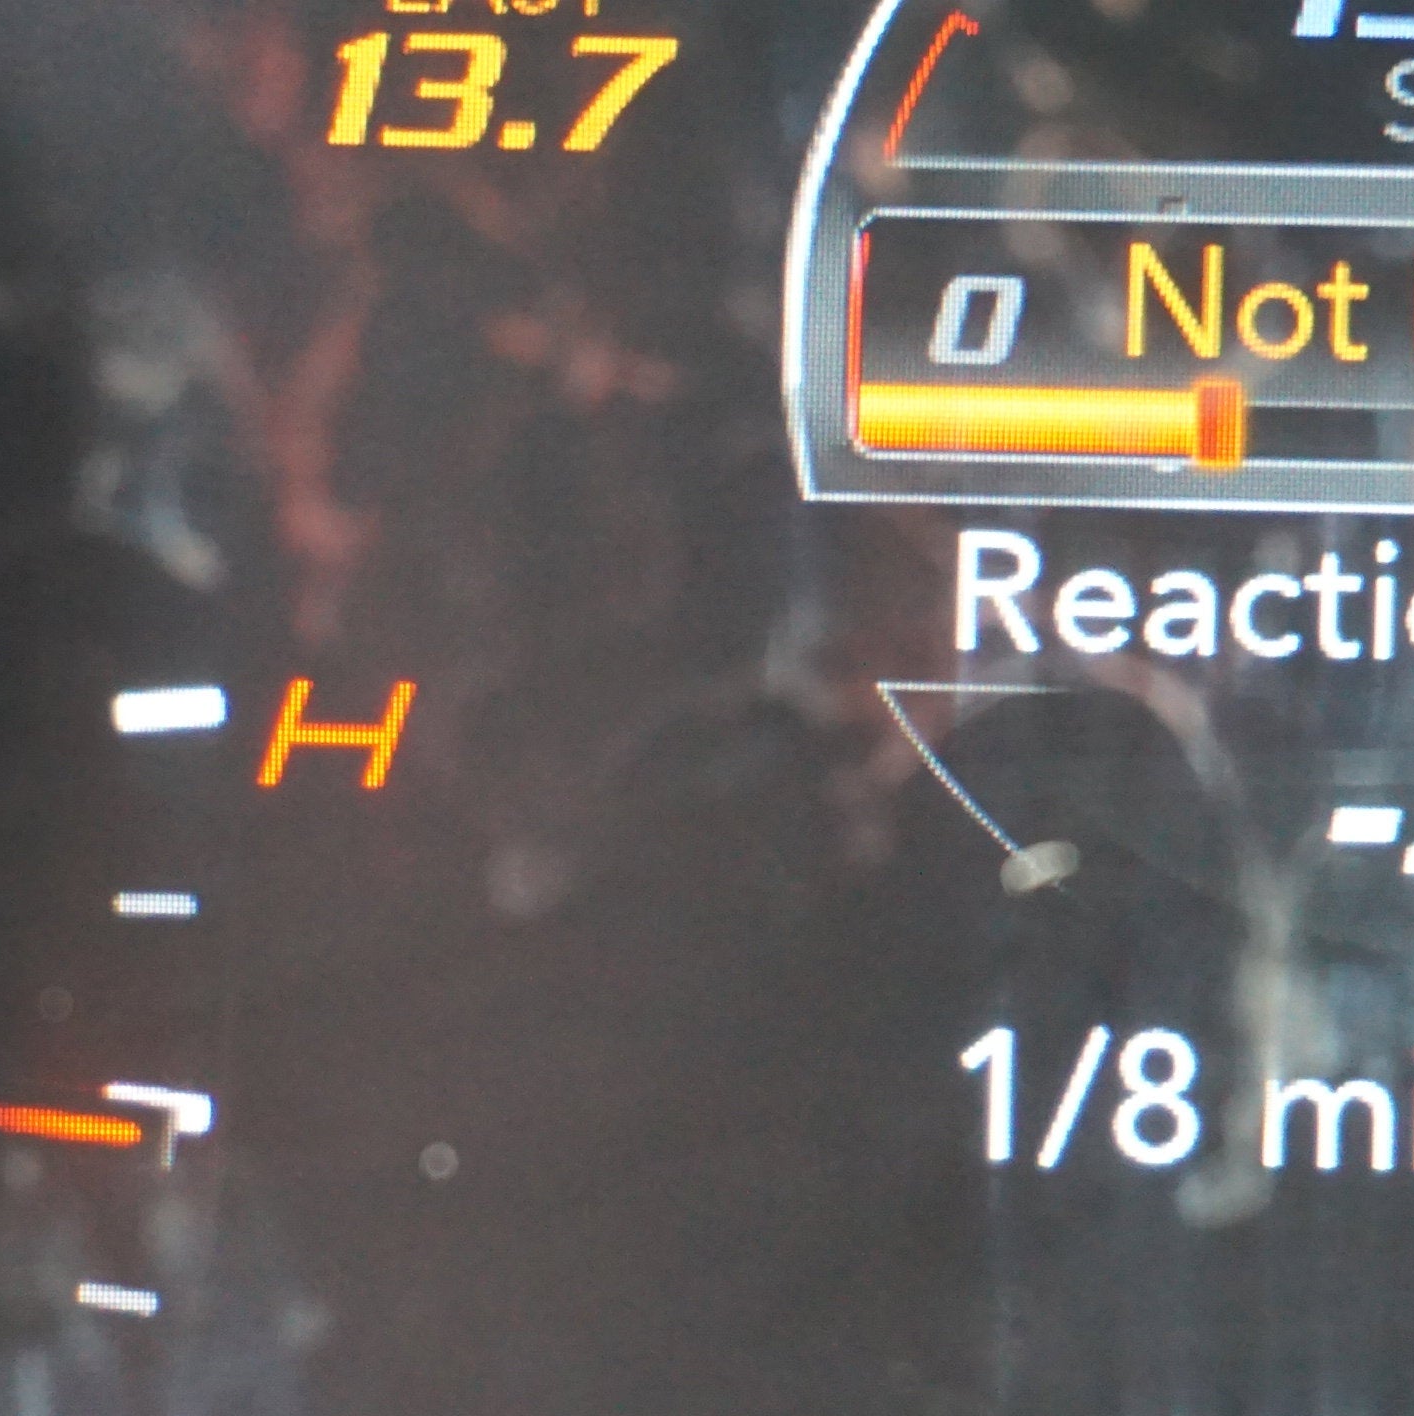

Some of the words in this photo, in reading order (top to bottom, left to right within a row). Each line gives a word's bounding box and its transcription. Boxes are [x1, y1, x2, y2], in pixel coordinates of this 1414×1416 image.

[327, 33, 679, 151] 13.7
[929, 276, 1024, 365] 0
[1126, 243, 1368, 362] Not
[257, 679, 416, 789] H
[960, 1024, 1201, 1168] 1/8
